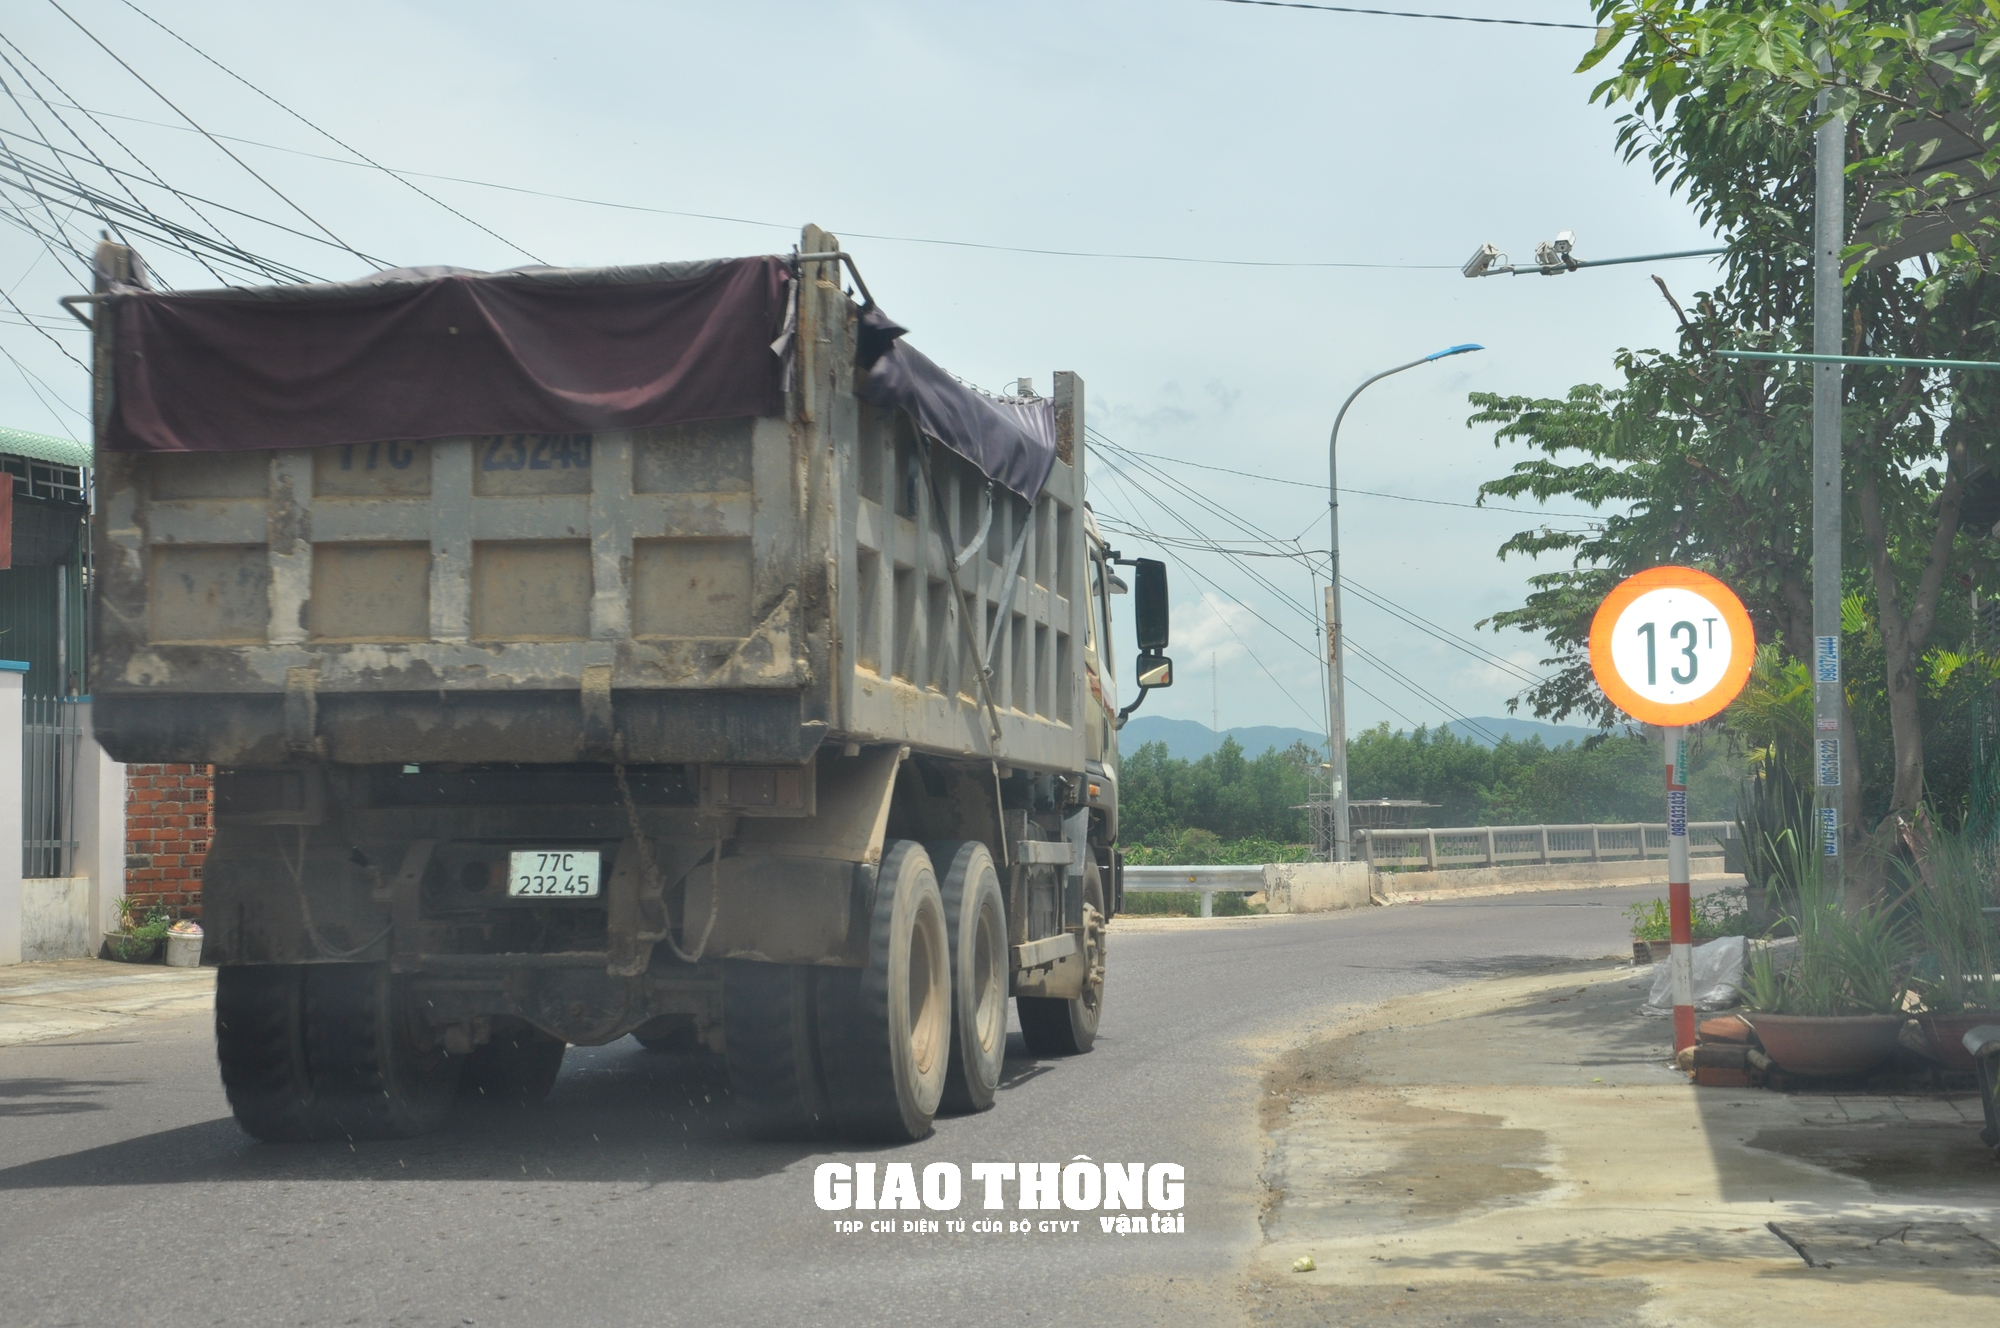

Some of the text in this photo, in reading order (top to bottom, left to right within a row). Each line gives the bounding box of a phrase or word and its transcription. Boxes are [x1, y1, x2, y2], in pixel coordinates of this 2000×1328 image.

[1637, 617, 1718, 685] 13 T
[537, 853, 574, 872] 77C
[518, 875, 589, 894] 232.45
